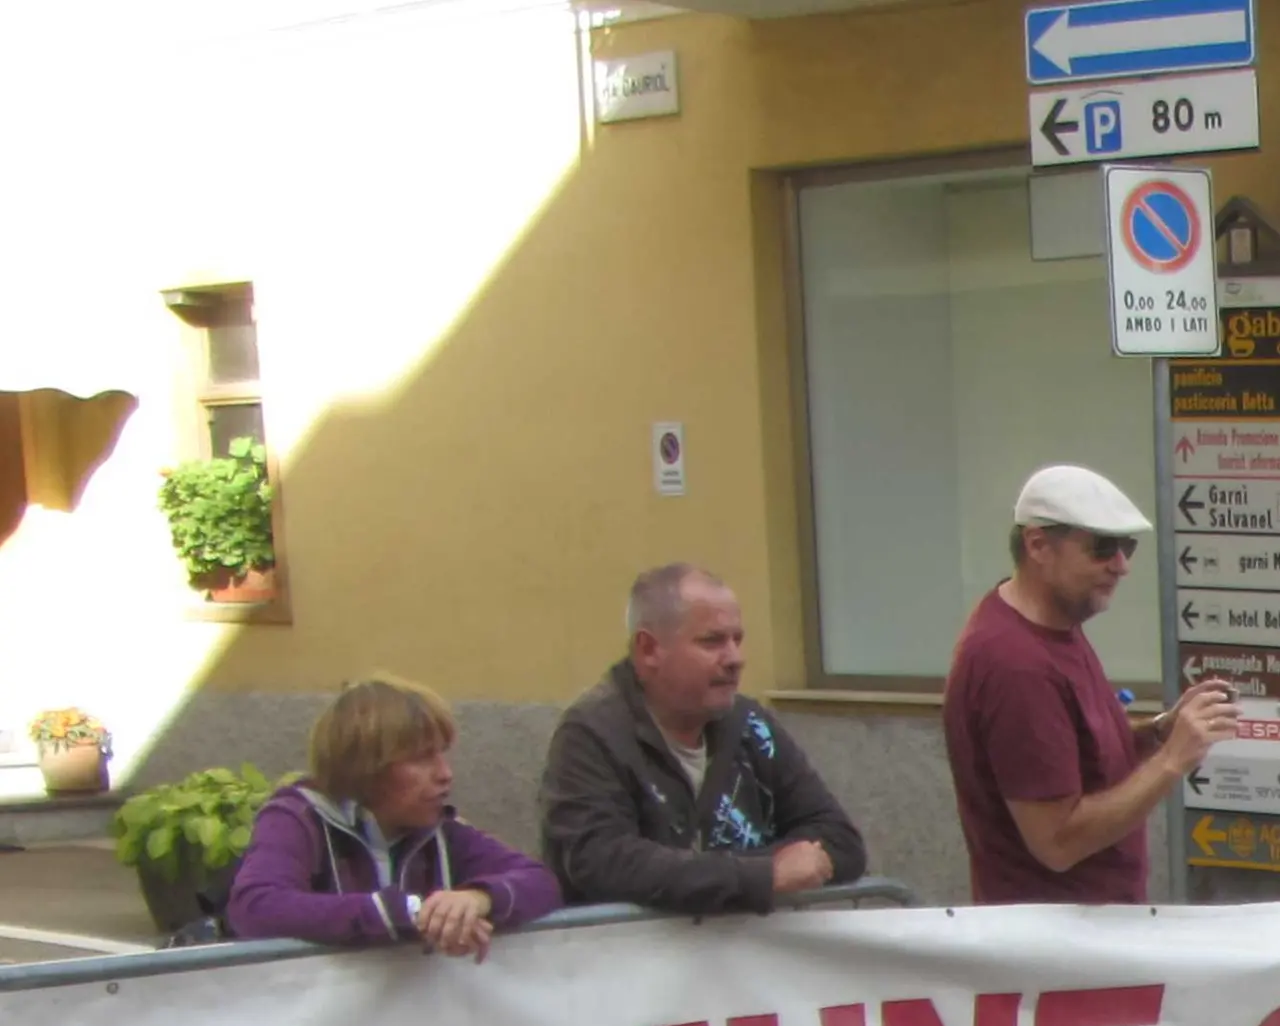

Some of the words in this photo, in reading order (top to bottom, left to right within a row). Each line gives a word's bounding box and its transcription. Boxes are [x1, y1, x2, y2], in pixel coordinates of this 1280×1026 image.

[1152, 98, 1194, 133] 80
[1204, 112, 1222, 130] m
[1093, 106, 1117, 149] P
[1125, 317, 1162, 333] AMBO
[1170, 317, 1175, 332] I
[1183, 316, 1208, 332] LATI
[1174, 368, 1223, 390] panificio
[1174, 392, 1237, 416] pasticceria
[1231, 427, 1279, 447] Promozione
[1209, 485, 1249, 505] Garni
[1210, 508, 1274, 530] Salvanel
[1239, 553, 1269, 573] garni
[1229, 609, 1259, 628] hotel
